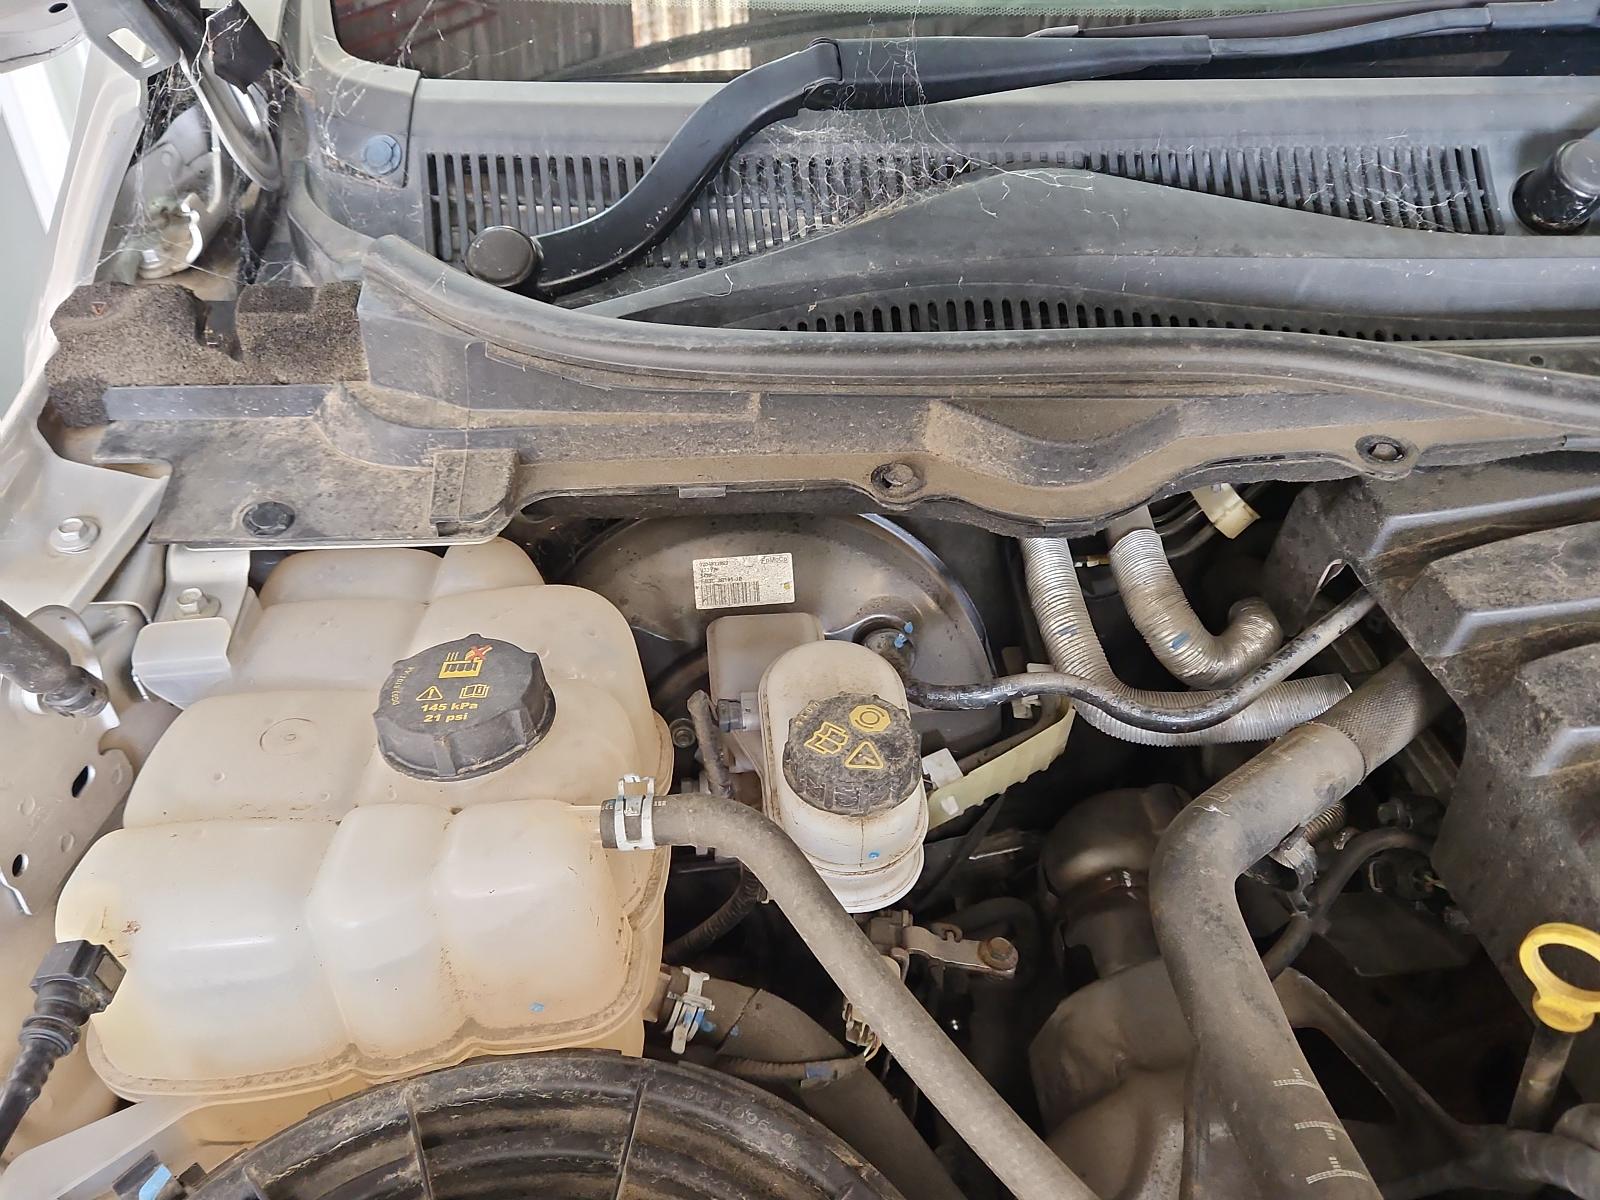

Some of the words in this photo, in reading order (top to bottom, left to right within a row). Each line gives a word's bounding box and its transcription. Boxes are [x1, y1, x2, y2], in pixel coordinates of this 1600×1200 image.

[421, 703, 448, 712] 145
[451, 702, 479, 711] kPa
[423, 713, 442, 723] 21
[445, 712, 469, 723] psi
